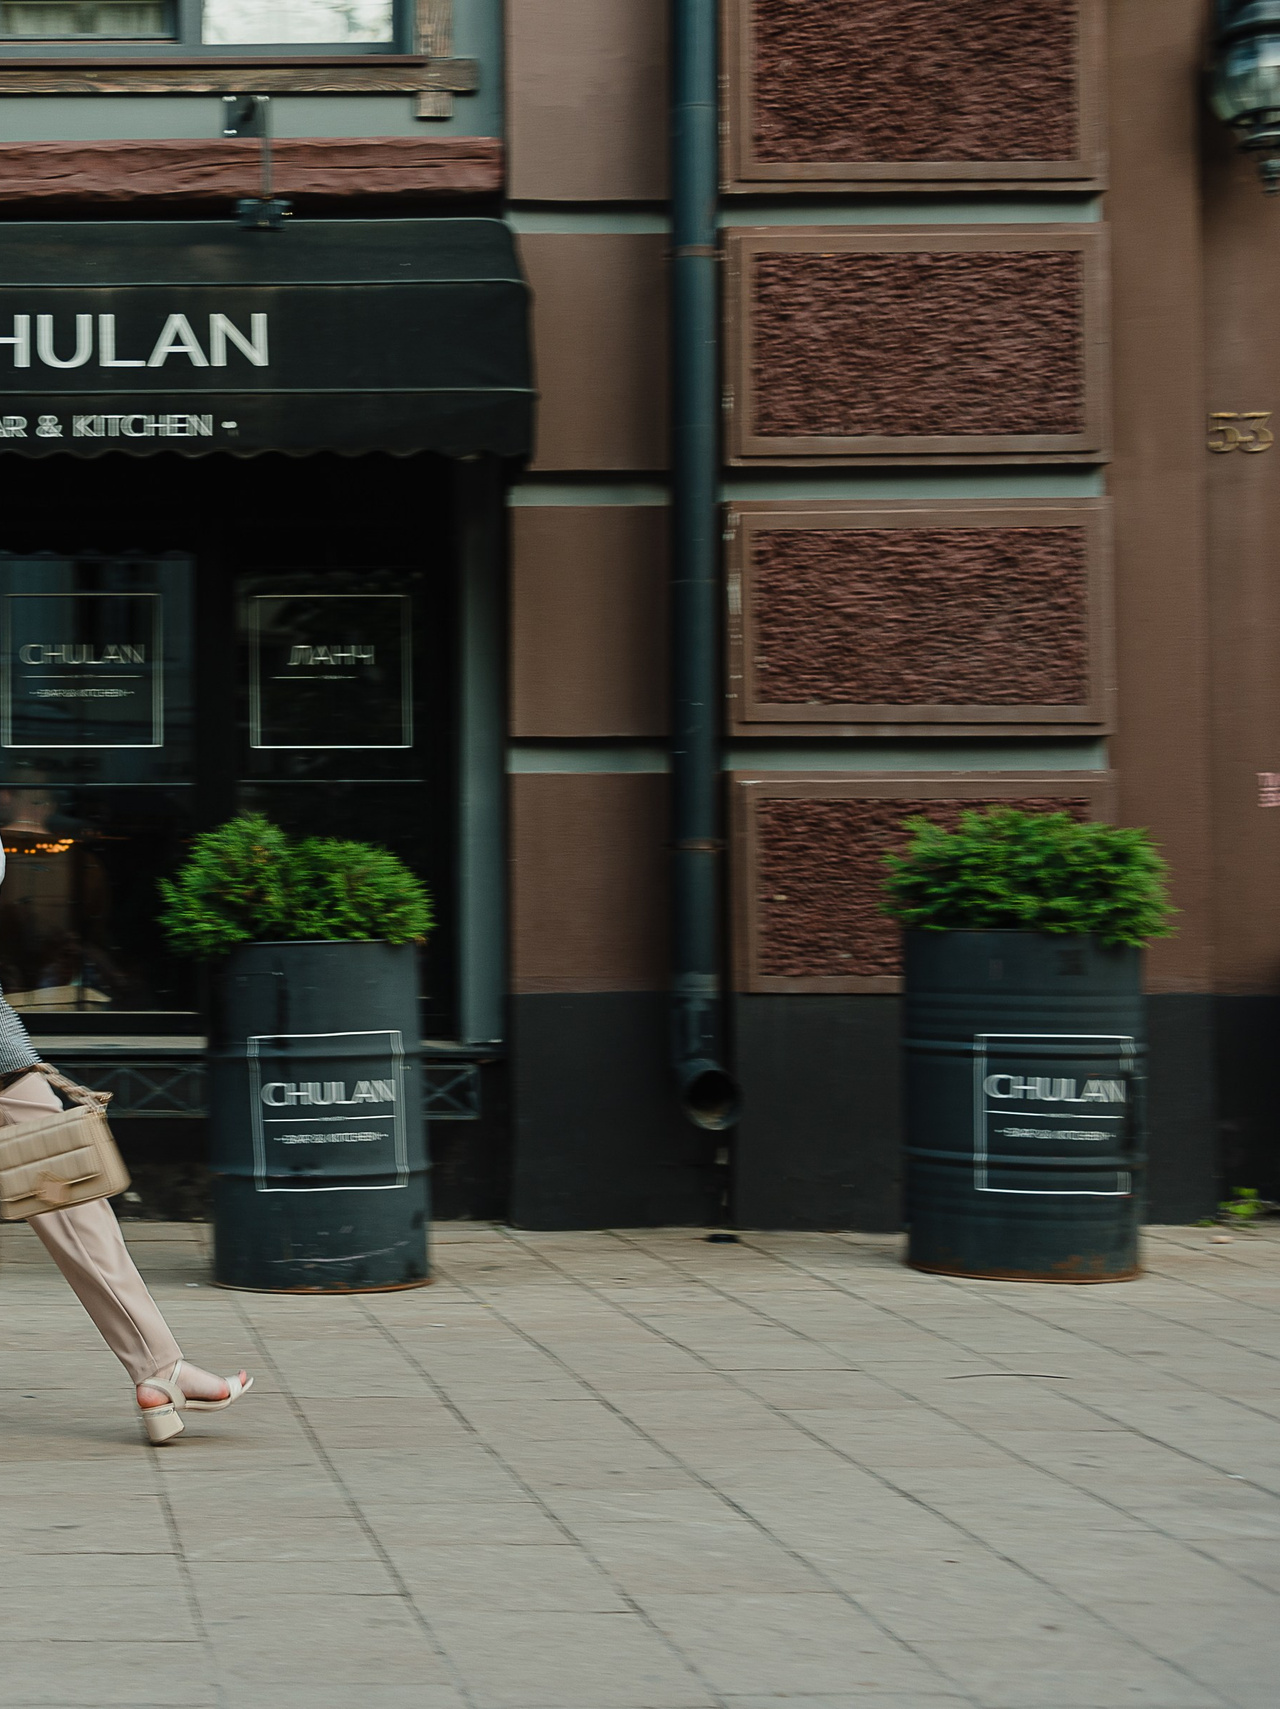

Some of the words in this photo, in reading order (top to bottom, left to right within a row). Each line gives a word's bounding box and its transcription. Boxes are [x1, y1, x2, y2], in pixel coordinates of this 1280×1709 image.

[35, 415, 64, 438] &
[72, 414, 214, 437] KITCHEN
[1207, 411, 1274, 453] 53
[19, 644, 146, 665] CHULAN
[286, 645, 375, 666] ЛАНЧ
[260, 1079, 397, 1107] CHULAN
[983, 1074, 1127, 1103] CHULAN
